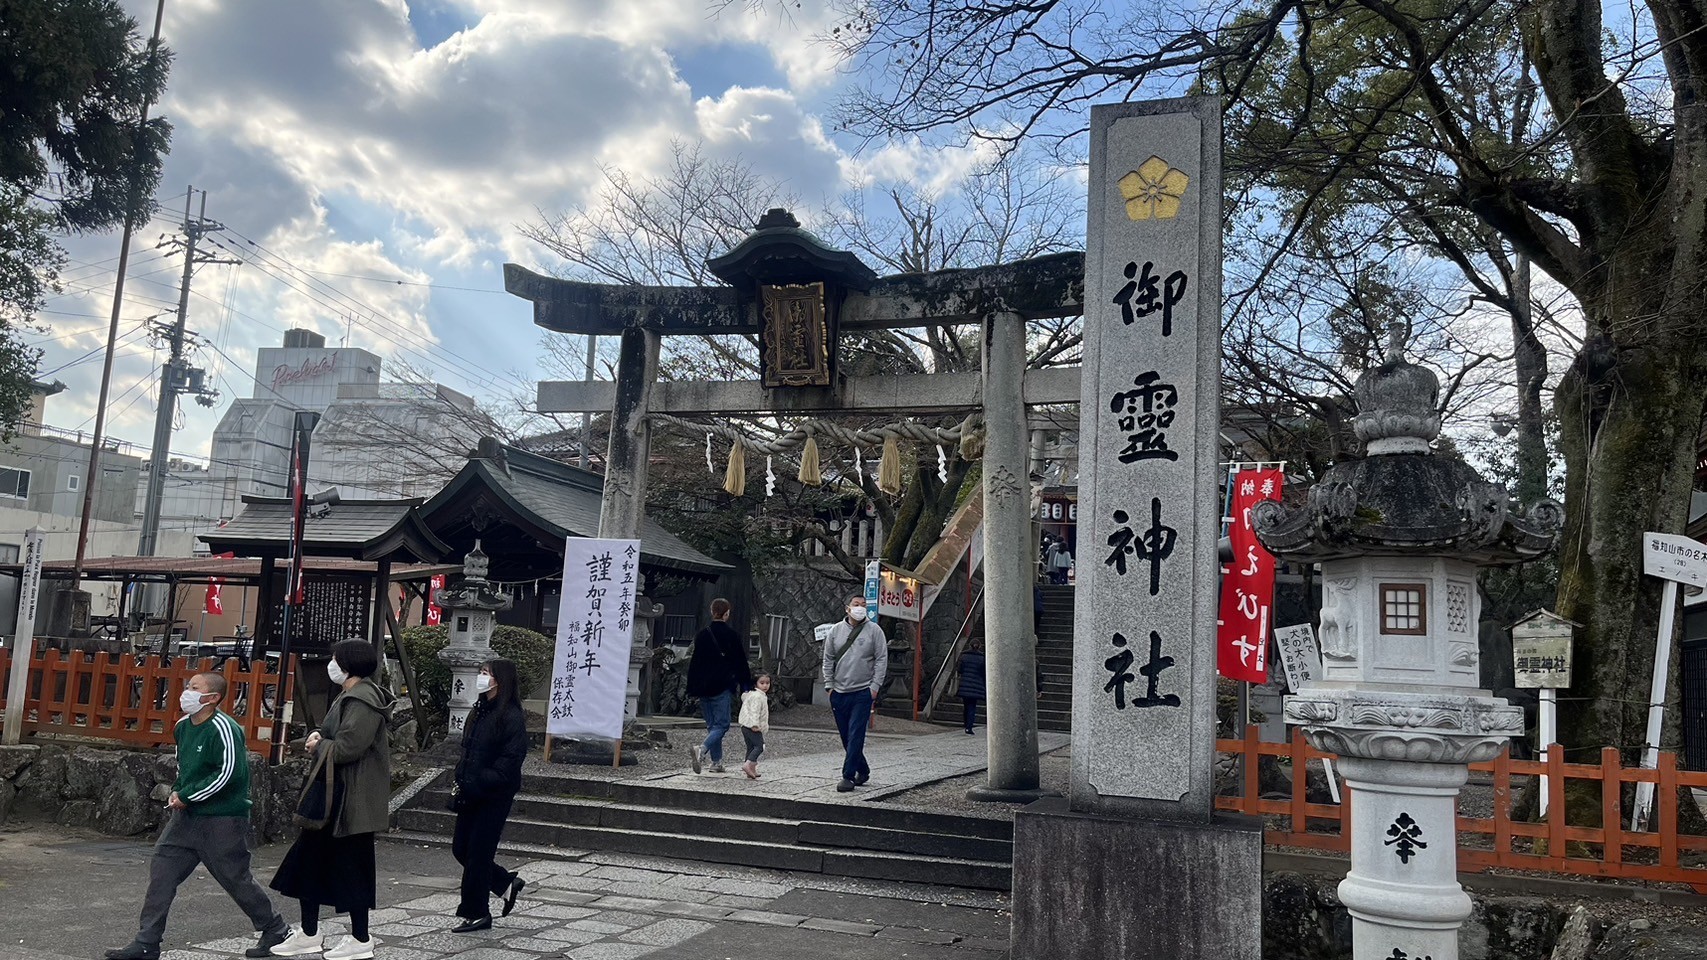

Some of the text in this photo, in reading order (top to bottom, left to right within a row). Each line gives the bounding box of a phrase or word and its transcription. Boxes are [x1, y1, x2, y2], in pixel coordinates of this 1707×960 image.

[578, 551, 613, 676] 謹賀新年
[617, 544, 637, 632] 令和五年癸卯
[550, 677, 564, 719] 保存会
